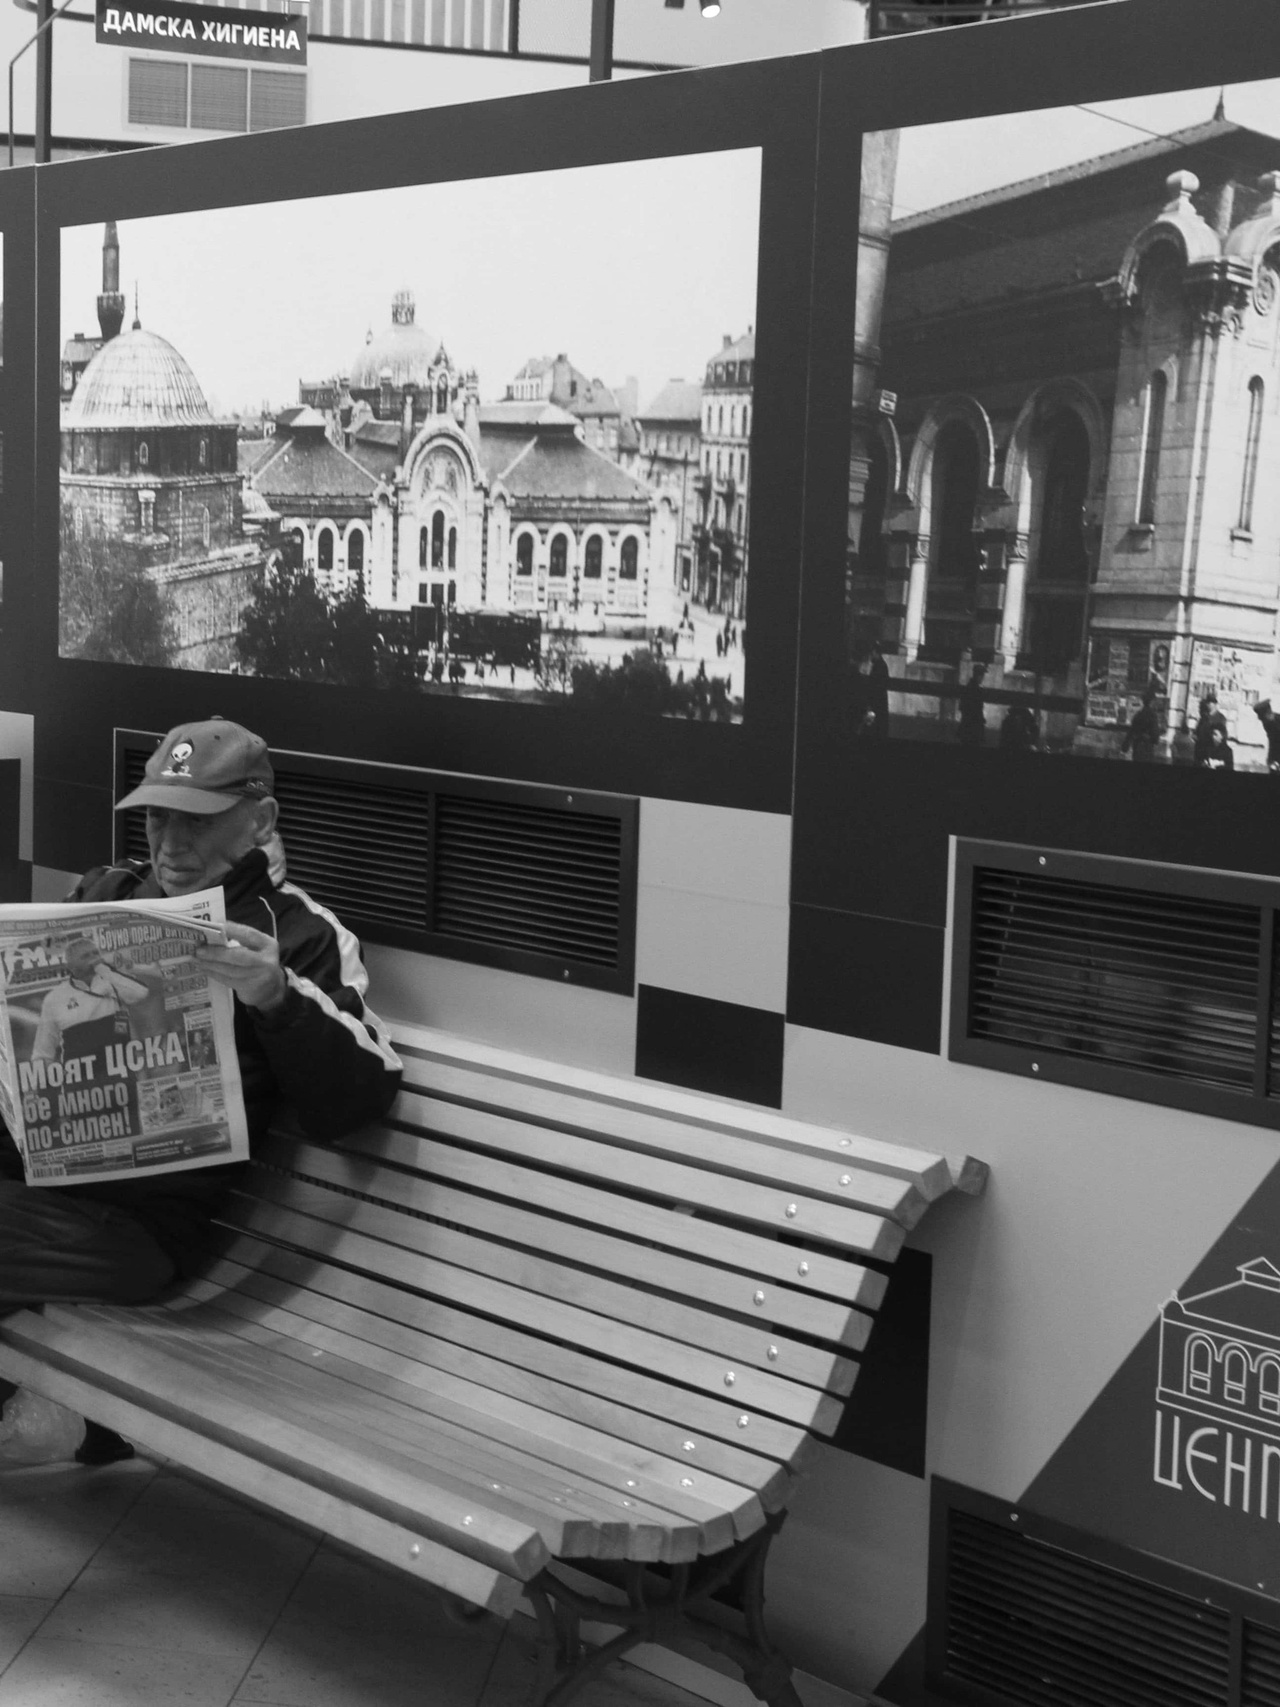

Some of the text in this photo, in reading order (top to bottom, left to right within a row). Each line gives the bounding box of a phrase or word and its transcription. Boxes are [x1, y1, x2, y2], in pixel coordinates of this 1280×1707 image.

[103, 9, 301, 50] ДАМСКА ХИГИЕНА
[99, 927, 129, 951] Бруно
[131, 925, 162, 946] преди
[19, 1055, 97, 1093] Моят
[105, 1032, 186, 1078] ЦСКА
[23, 1082, 129, 1124] бе много
[26, 1106, 132, 1151] по-силен!
